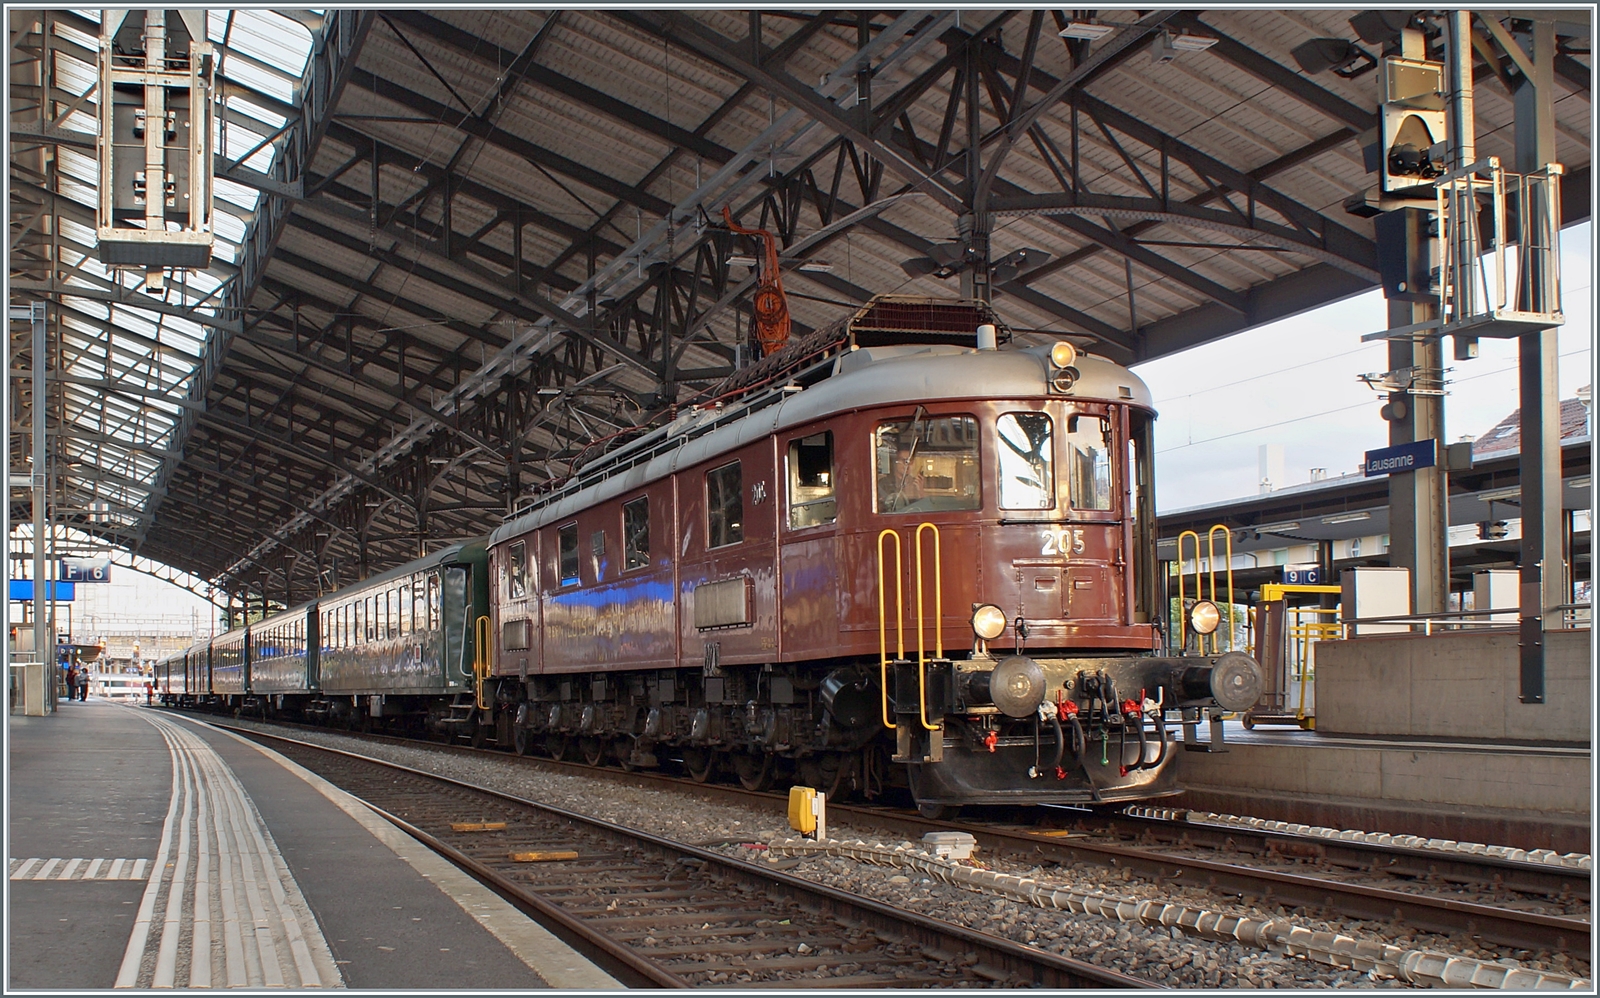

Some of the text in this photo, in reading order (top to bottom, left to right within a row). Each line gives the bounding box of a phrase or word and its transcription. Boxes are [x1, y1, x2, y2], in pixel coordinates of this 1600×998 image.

[1366, 454, 1414, 472] Lausanne
[1041, 529, 1085, 556] 205
[68, 566, 103, 580] F 6
[1289, 571, 1317, 583] 9 C
